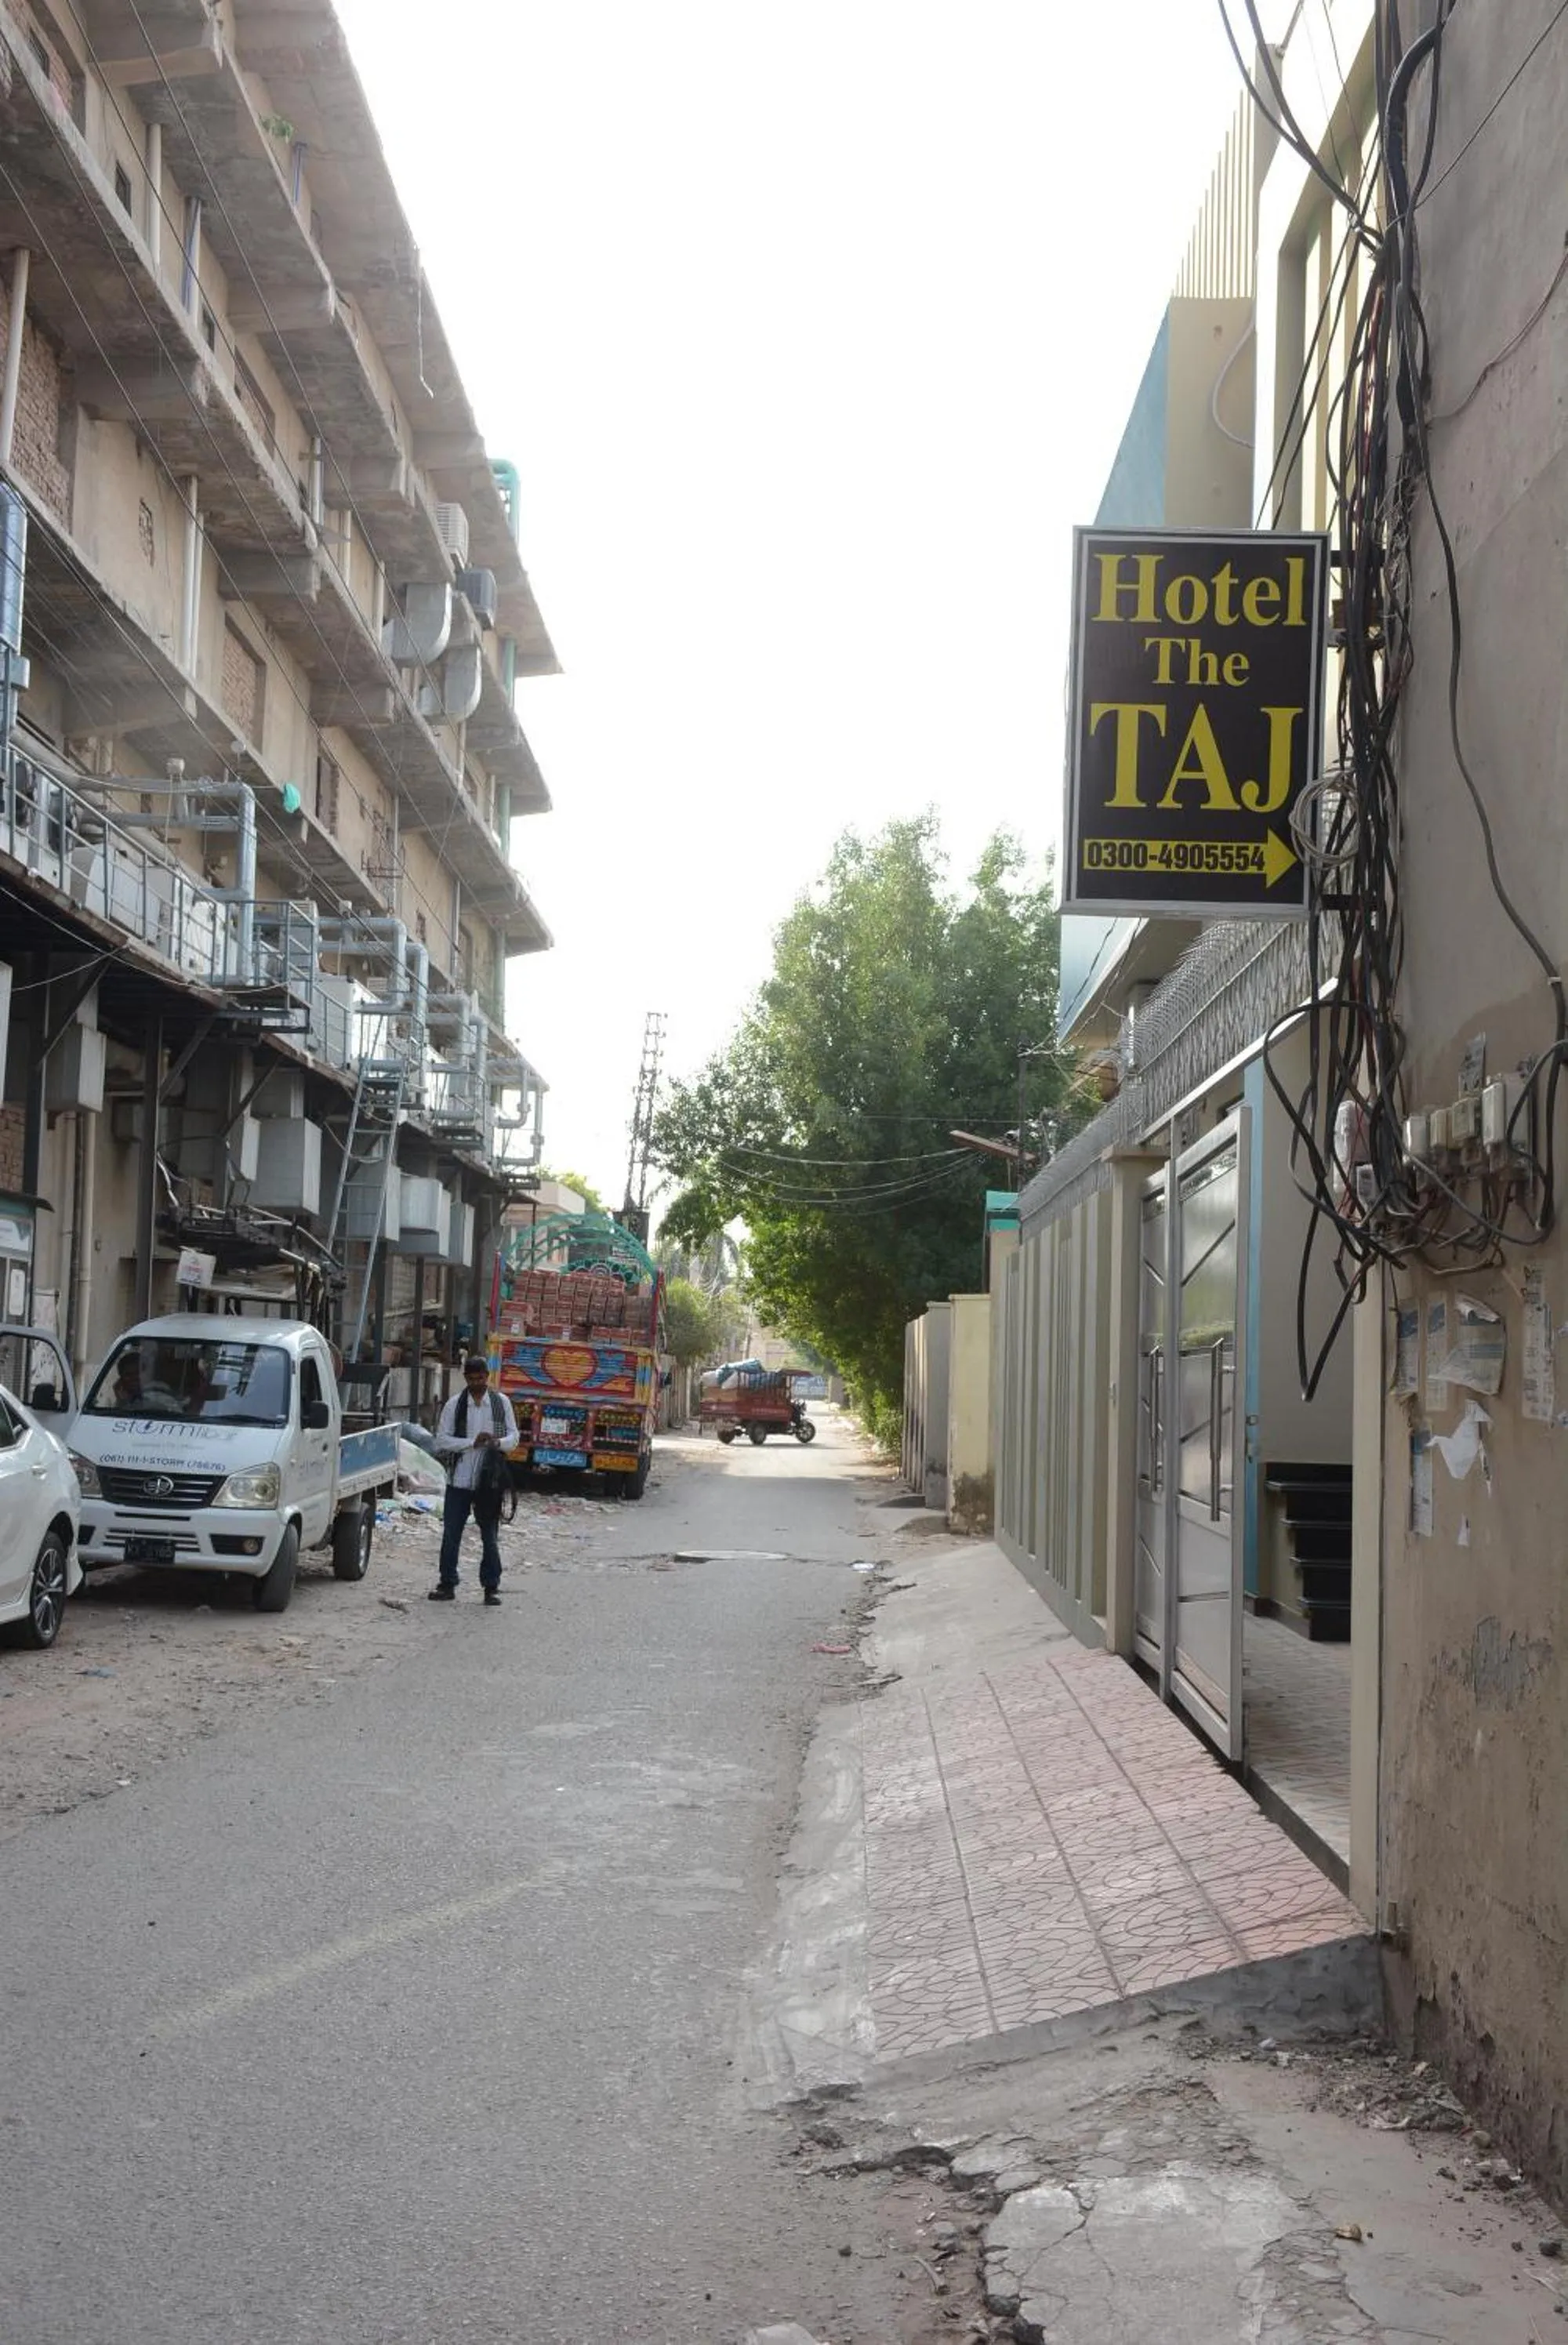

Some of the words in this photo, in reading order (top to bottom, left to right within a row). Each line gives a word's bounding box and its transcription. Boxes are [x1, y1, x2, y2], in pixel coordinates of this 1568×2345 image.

[1091, 554, 1307, 626] Hotel
[1145, 637, 1250, 687] The
[1089, 702, 1305, 813] TAJ
[1087, 840, 1265, 872] 0300-4905554
